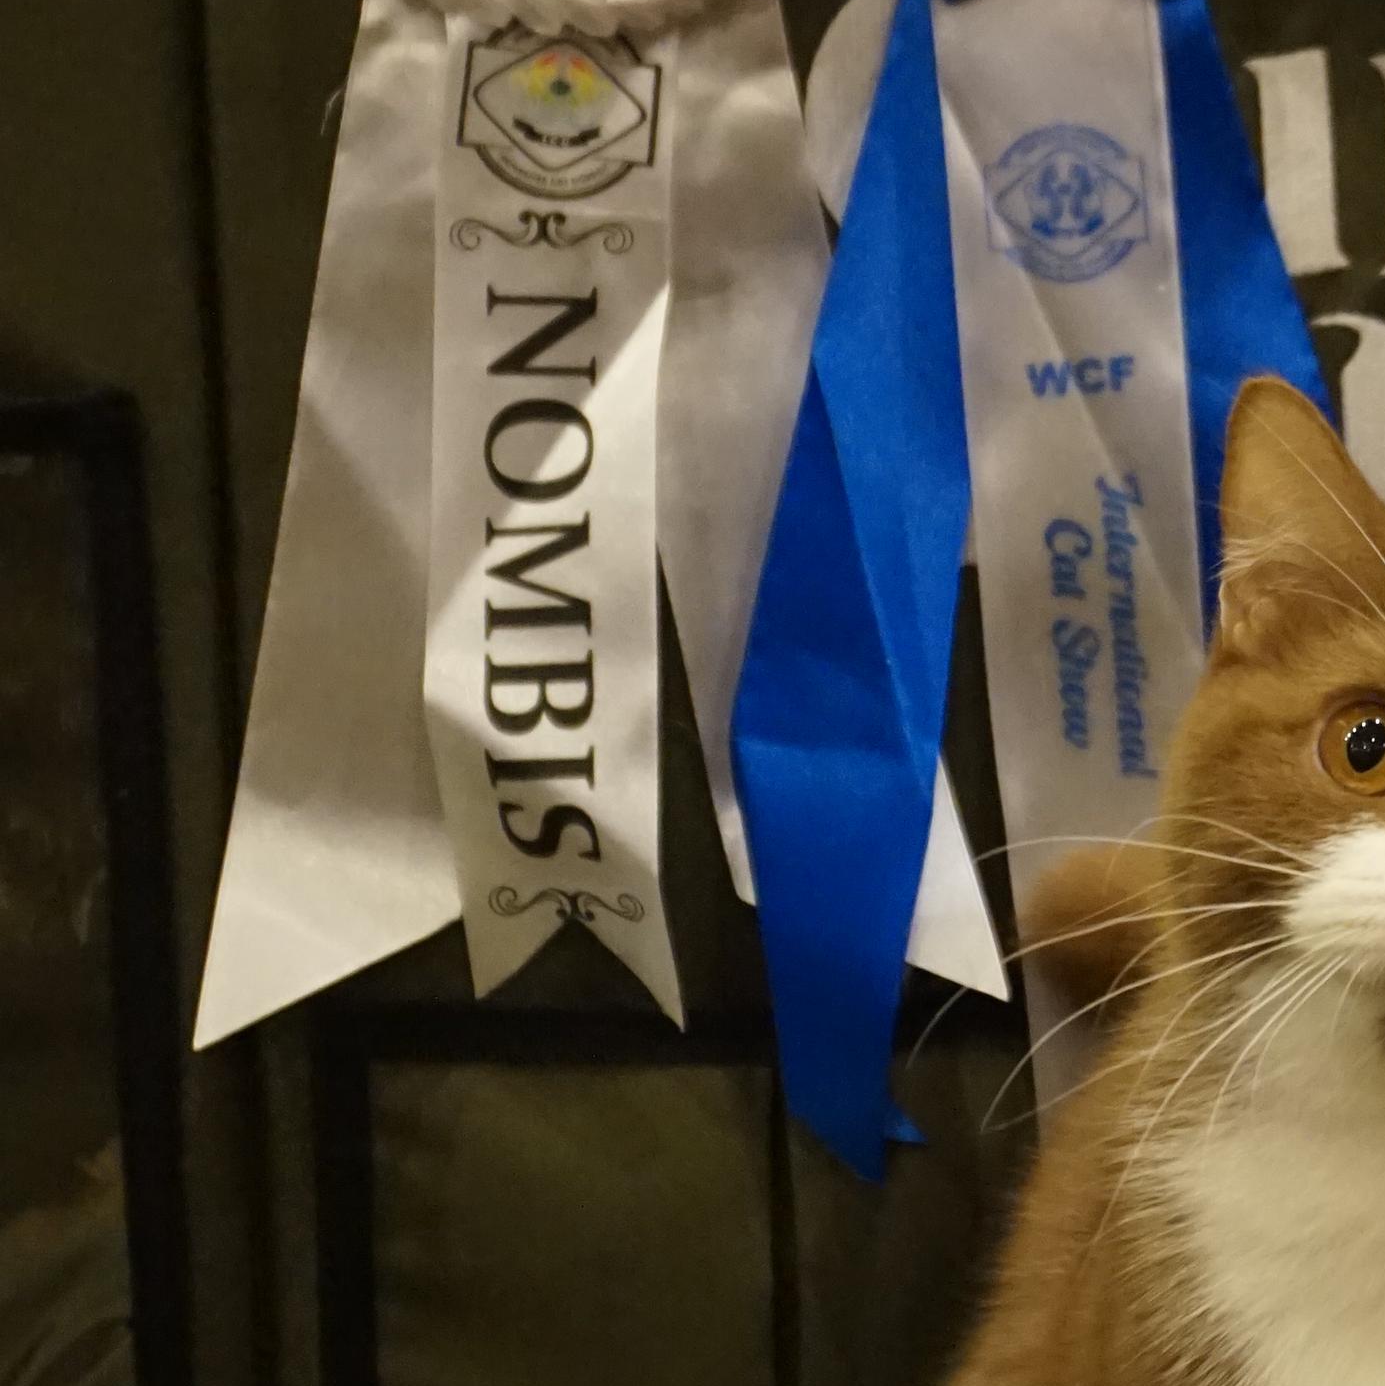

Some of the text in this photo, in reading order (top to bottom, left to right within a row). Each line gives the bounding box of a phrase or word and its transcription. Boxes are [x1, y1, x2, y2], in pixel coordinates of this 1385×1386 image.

[1027, 351, 1135, 397] WCF
[1044, 518, 1101, 750] Cat Show
[1095, 472, 1158, 779] International
